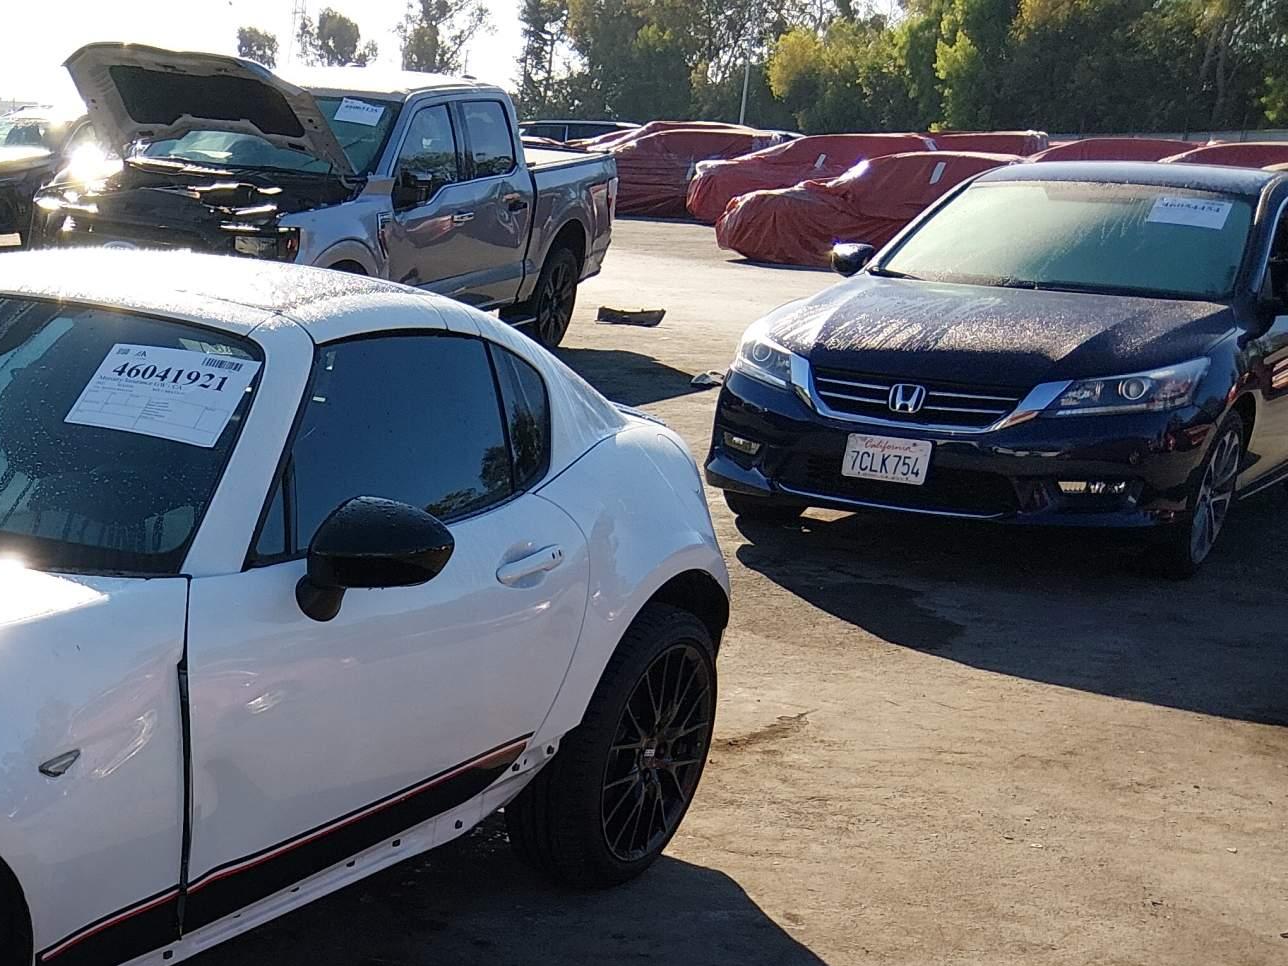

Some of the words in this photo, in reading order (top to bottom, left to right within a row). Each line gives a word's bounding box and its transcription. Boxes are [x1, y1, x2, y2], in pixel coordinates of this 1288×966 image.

[112, 362, 229, 392] 46041921
[865, 438, 913, 453] California
[851, 450, 920, 478] 7CLK754
